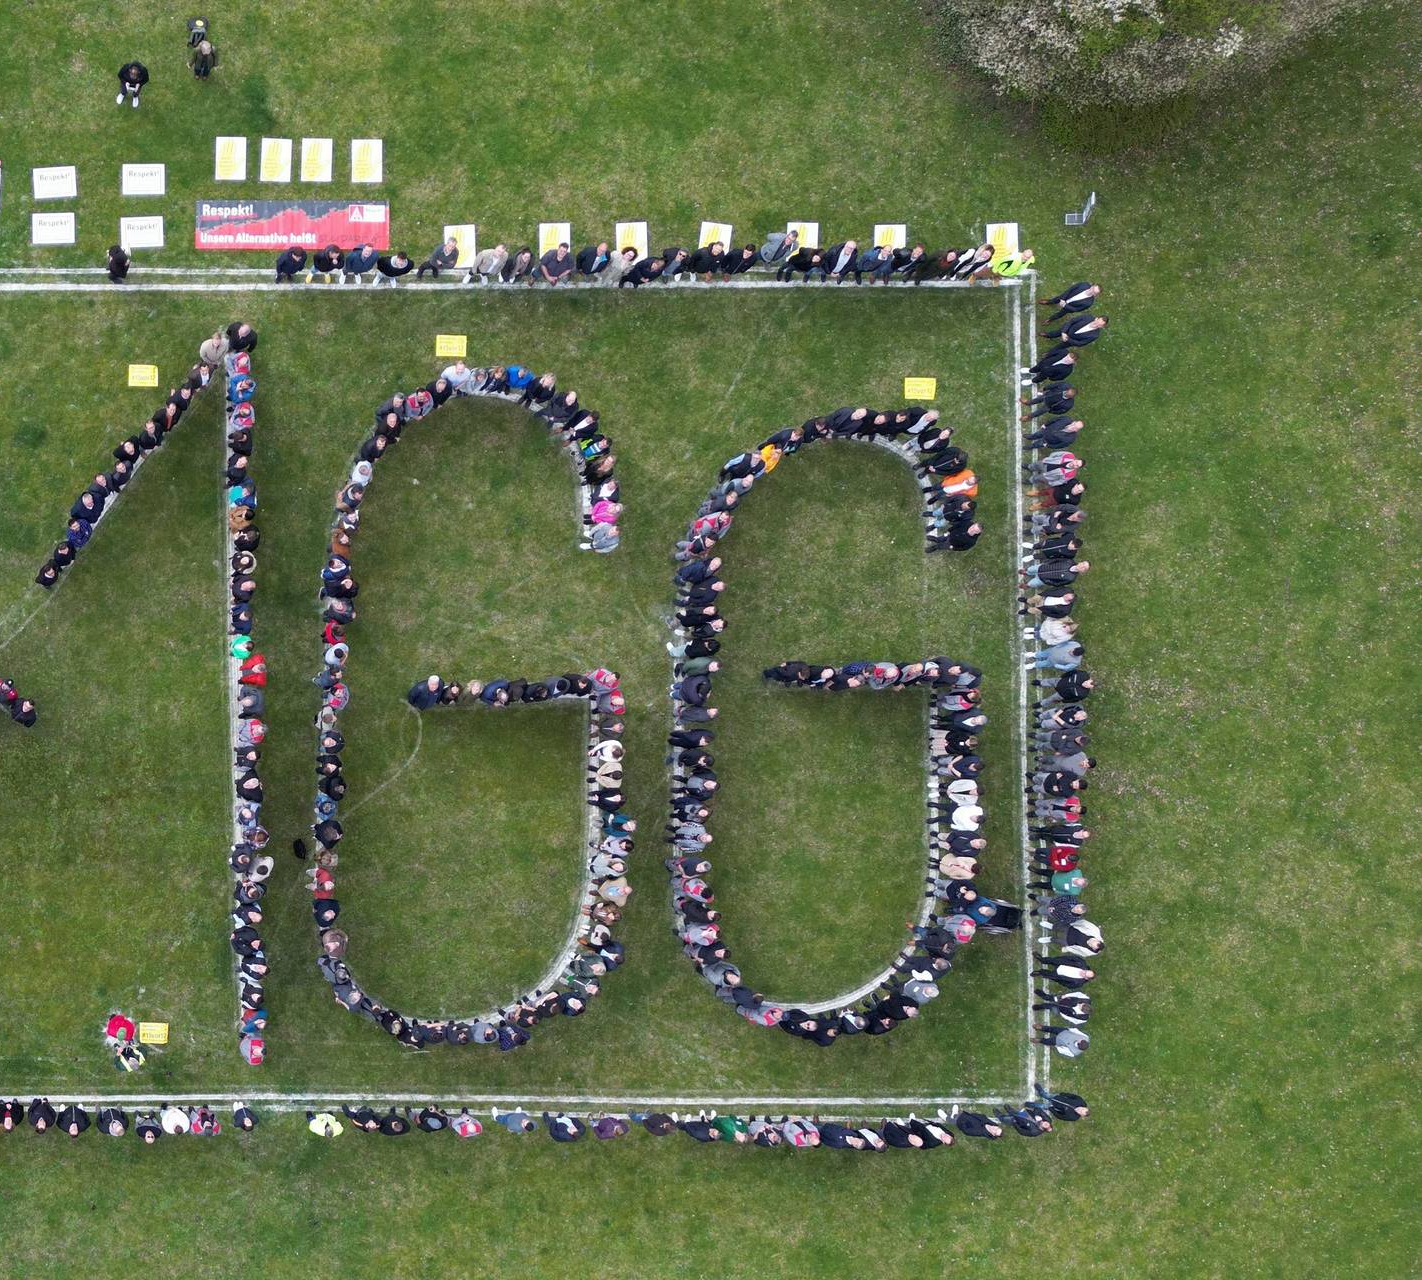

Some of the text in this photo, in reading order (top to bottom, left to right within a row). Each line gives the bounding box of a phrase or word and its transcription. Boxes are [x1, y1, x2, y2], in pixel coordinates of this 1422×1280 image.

[128, 170, 159, 179] Respekt!
[202, 203, 254, 219] Respekt!
[200, 232, 234, 244] Unsere
[235, 232, 289, 244] Alternative
[290, 232, 317, 244] heißt
